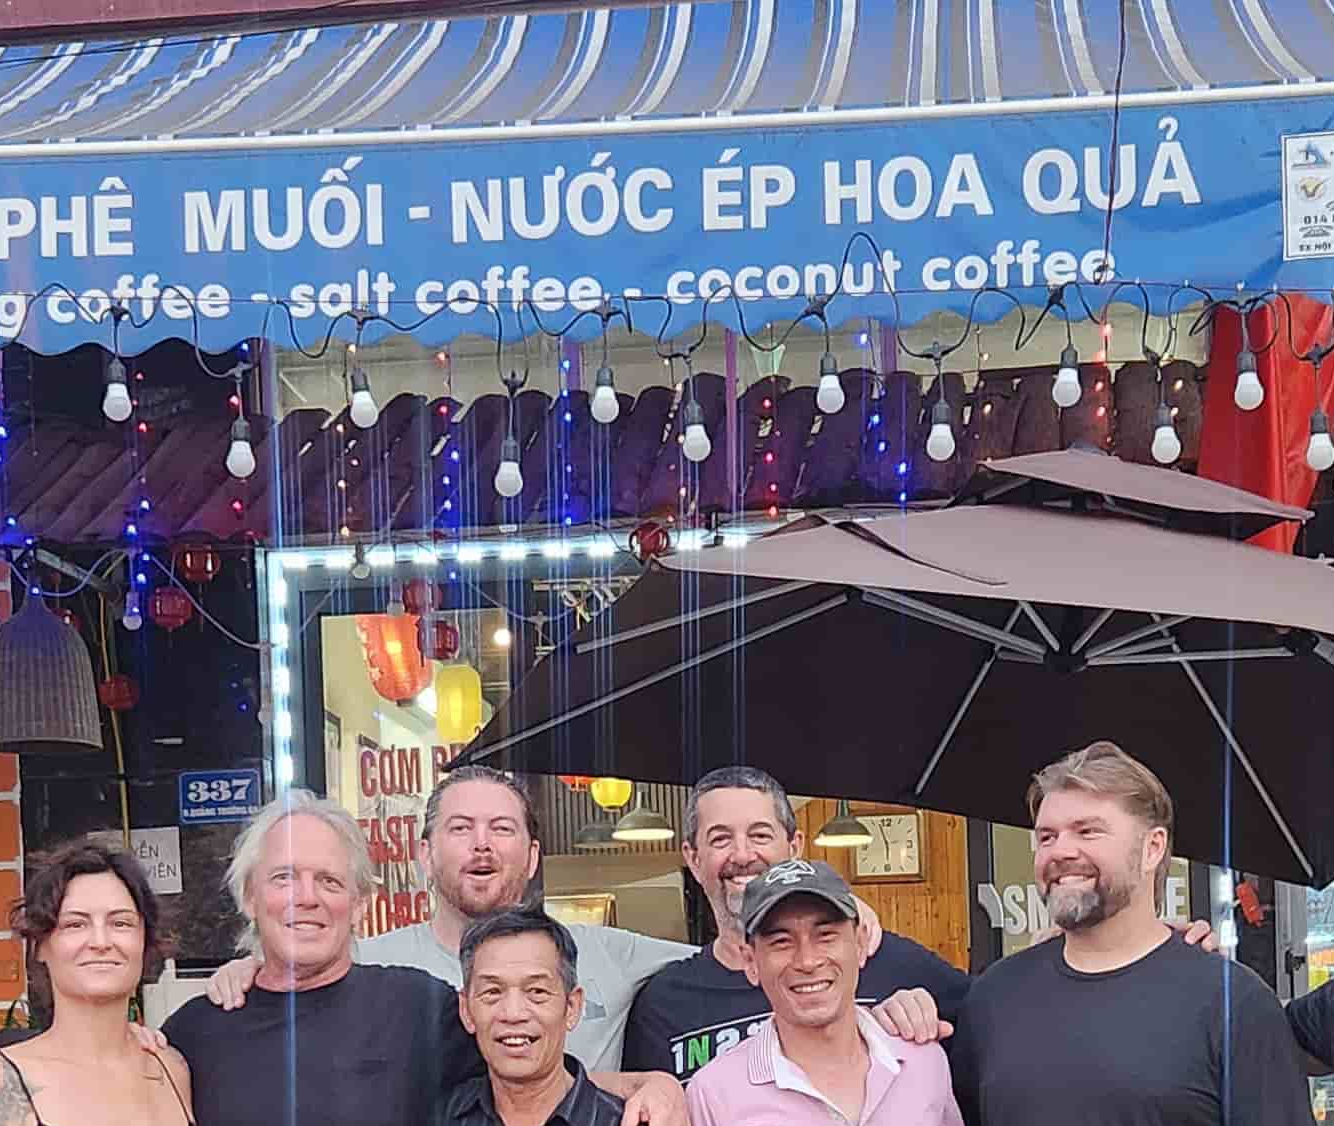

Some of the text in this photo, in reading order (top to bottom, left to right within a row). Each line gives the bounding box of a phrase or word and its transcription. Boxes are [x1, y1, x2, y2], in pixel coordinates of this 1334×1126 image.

[184, 156, 384, 253] MUỐI
[450, 152, 674, 243] NƯỚC
[702, 147, 796, 231] ÉP
[823, 153, 994, 226] HOA
[1022, 116, 1202, 215] QUẢ
[46, 273, 230, 328] coffee
[289, 269, 395, 319] salt
[415, 264, 603, 314] coffee
[667, 248, 902, 304] coconut
[922, 239, 1117, 291] coffee
[187, 778, 252, 803] 337
